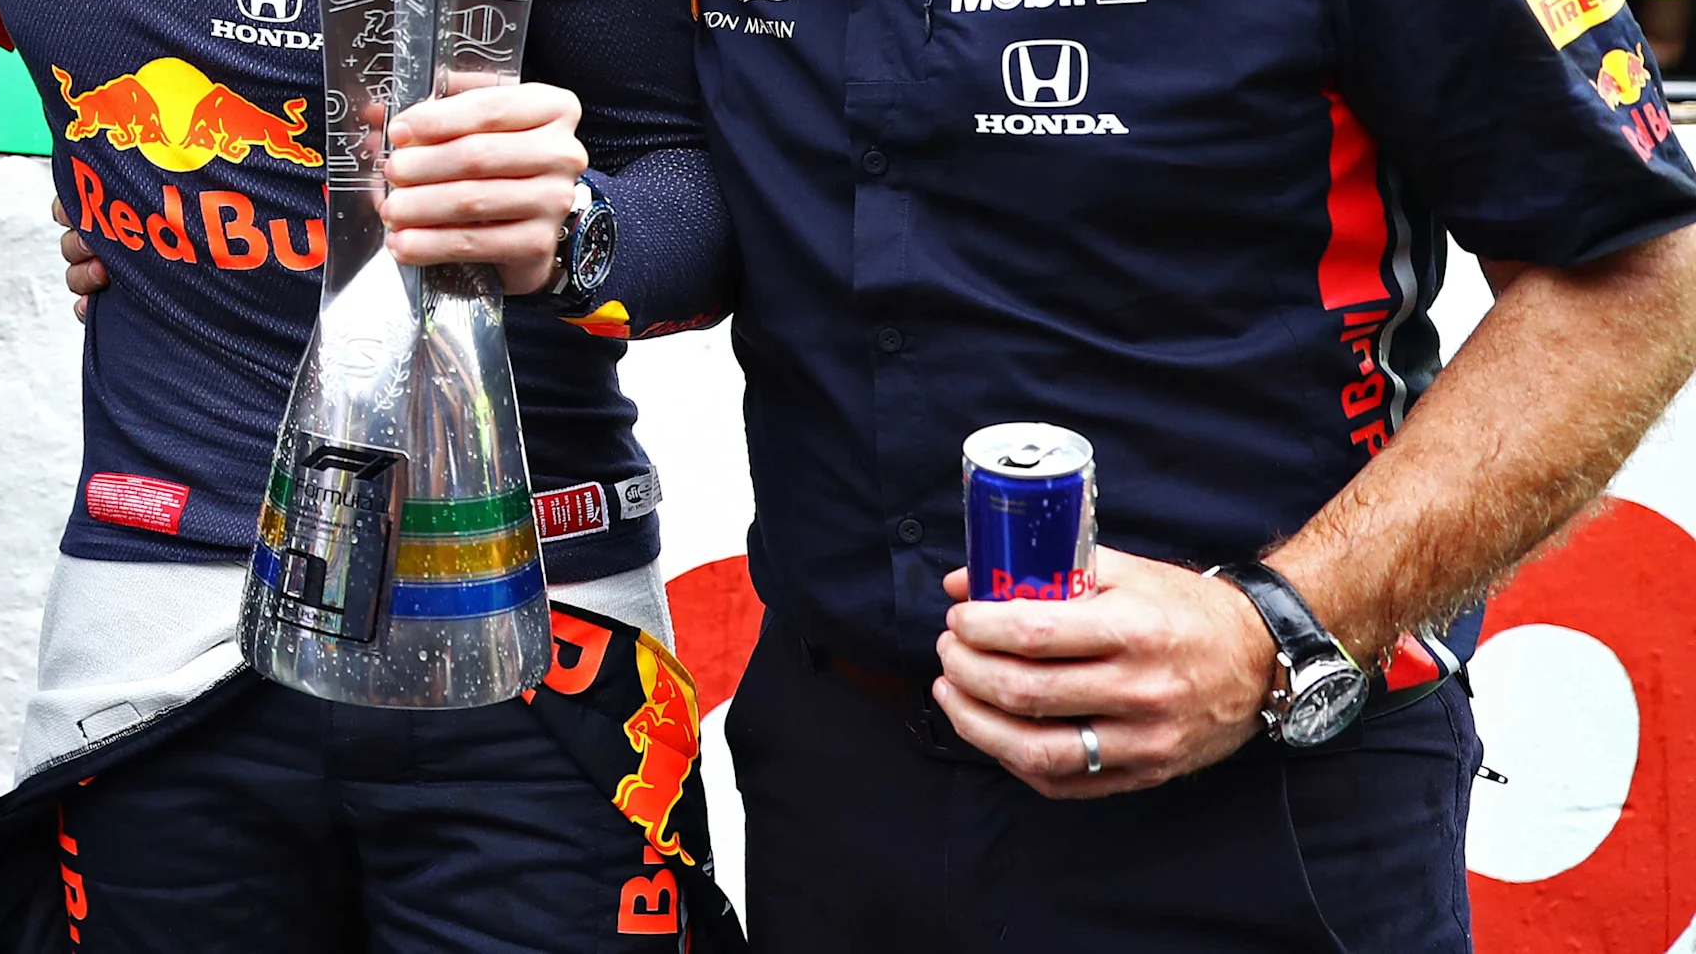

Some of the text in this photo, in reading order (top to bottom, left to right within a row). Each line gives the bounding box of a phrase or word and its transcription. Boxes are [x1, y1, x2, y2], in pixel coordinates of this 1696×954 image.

[703, 10, 740, 31] TON
[973, 113, 1130, 135] HONDA
[70, 156, 329, 272] Red Bu
[296, 477, 374, 511] Formula
[991, 566, 1097, 602] Red Bu
